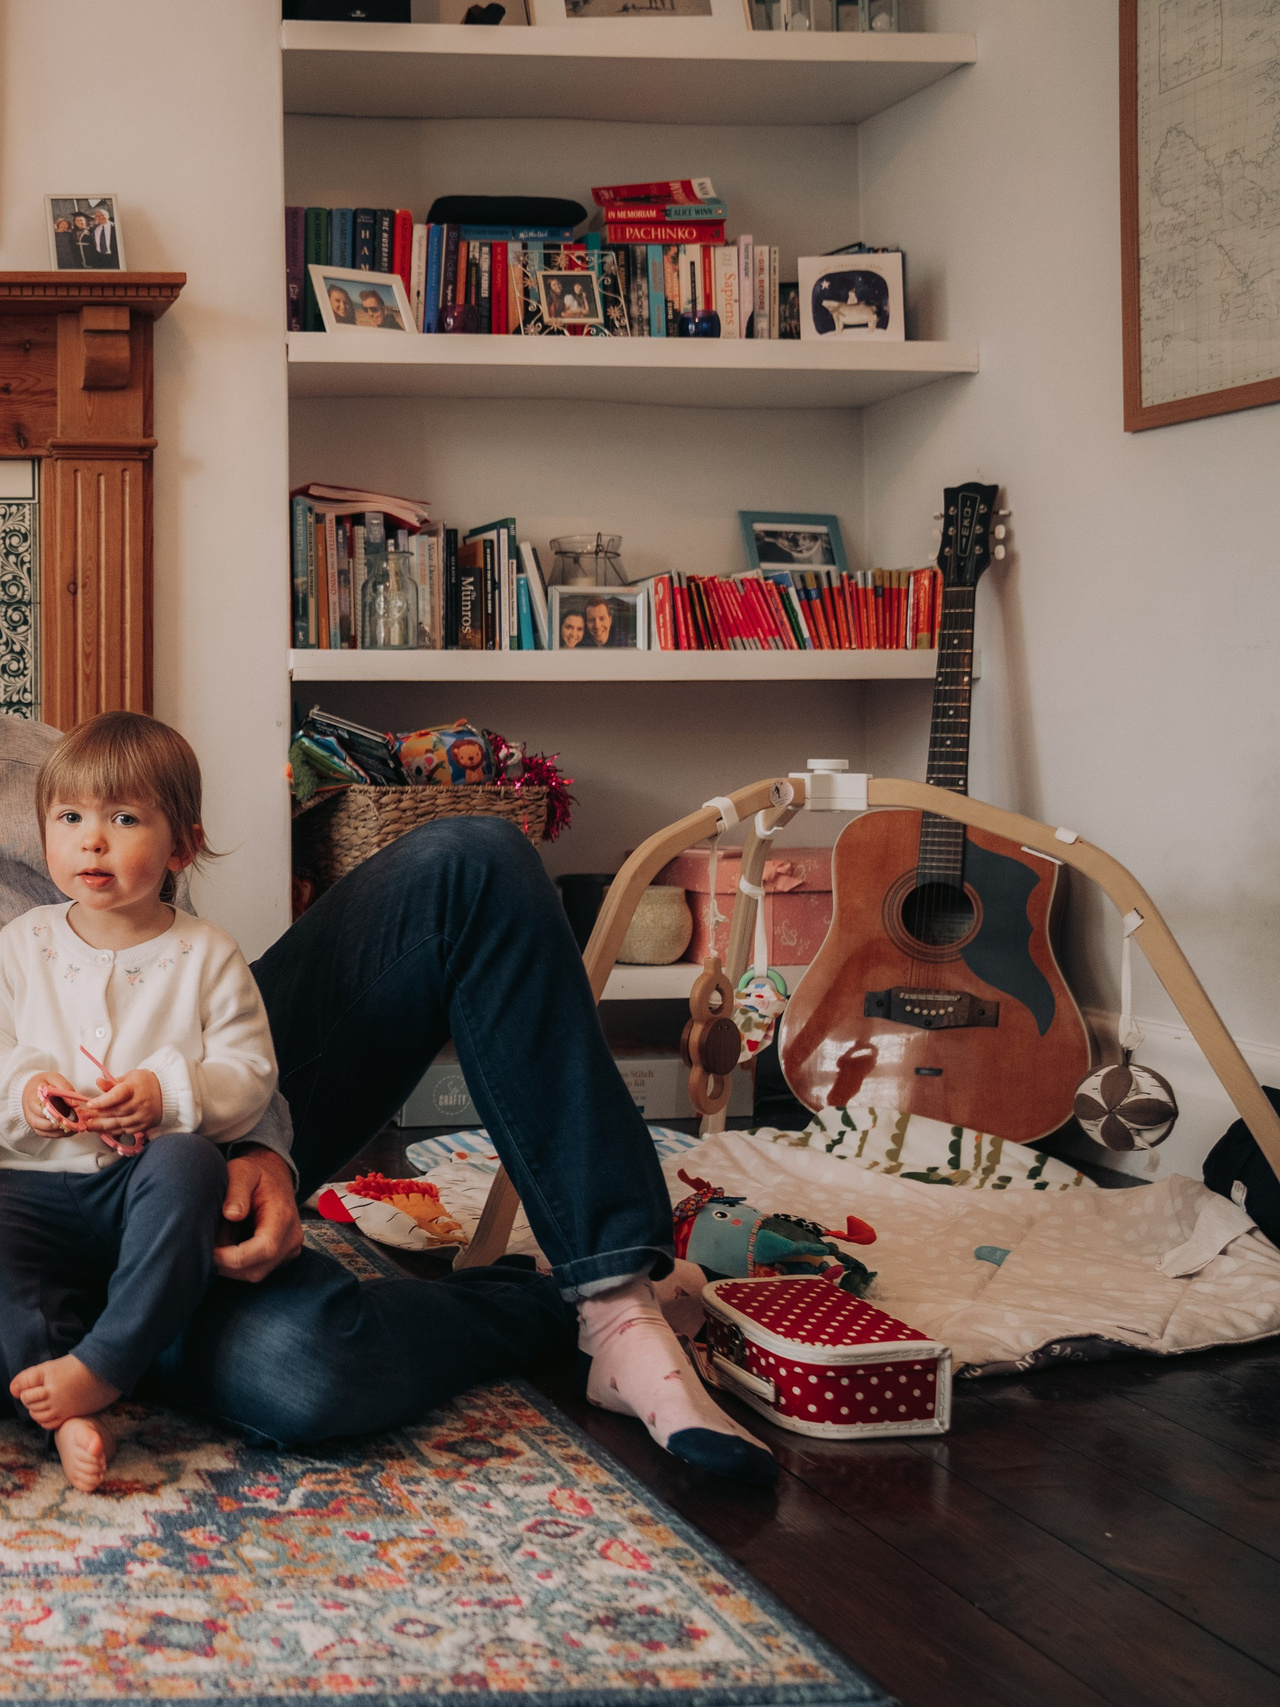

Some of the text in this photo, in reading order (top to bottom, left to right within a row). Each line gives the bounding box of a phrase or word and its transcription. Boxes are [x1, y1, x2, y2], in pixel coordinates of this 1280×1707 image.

[608, 208, 713, 219] IN MEMORIAM ALICE WINN
[381, 217, 390, 272] THE HUSBANDS
[449, 231, 458, 251] Blue
[625, 227, 697, 240] PACHINKO
[447, 254, 457, 281] Ticket
[481, 272, 489, 297] PADDLES
[721, 273, 736, 325] Sapiens
[961, 507, 972, 536] EKO
[429, 564, 437, 597] Doctor
[461, 577, 474, 633] Munros
[630, 1069, 654, 1079] Stitch
[633, 1078, 646, 1088] Kit
[438, 1094, 467, 1107] CRAFTY
